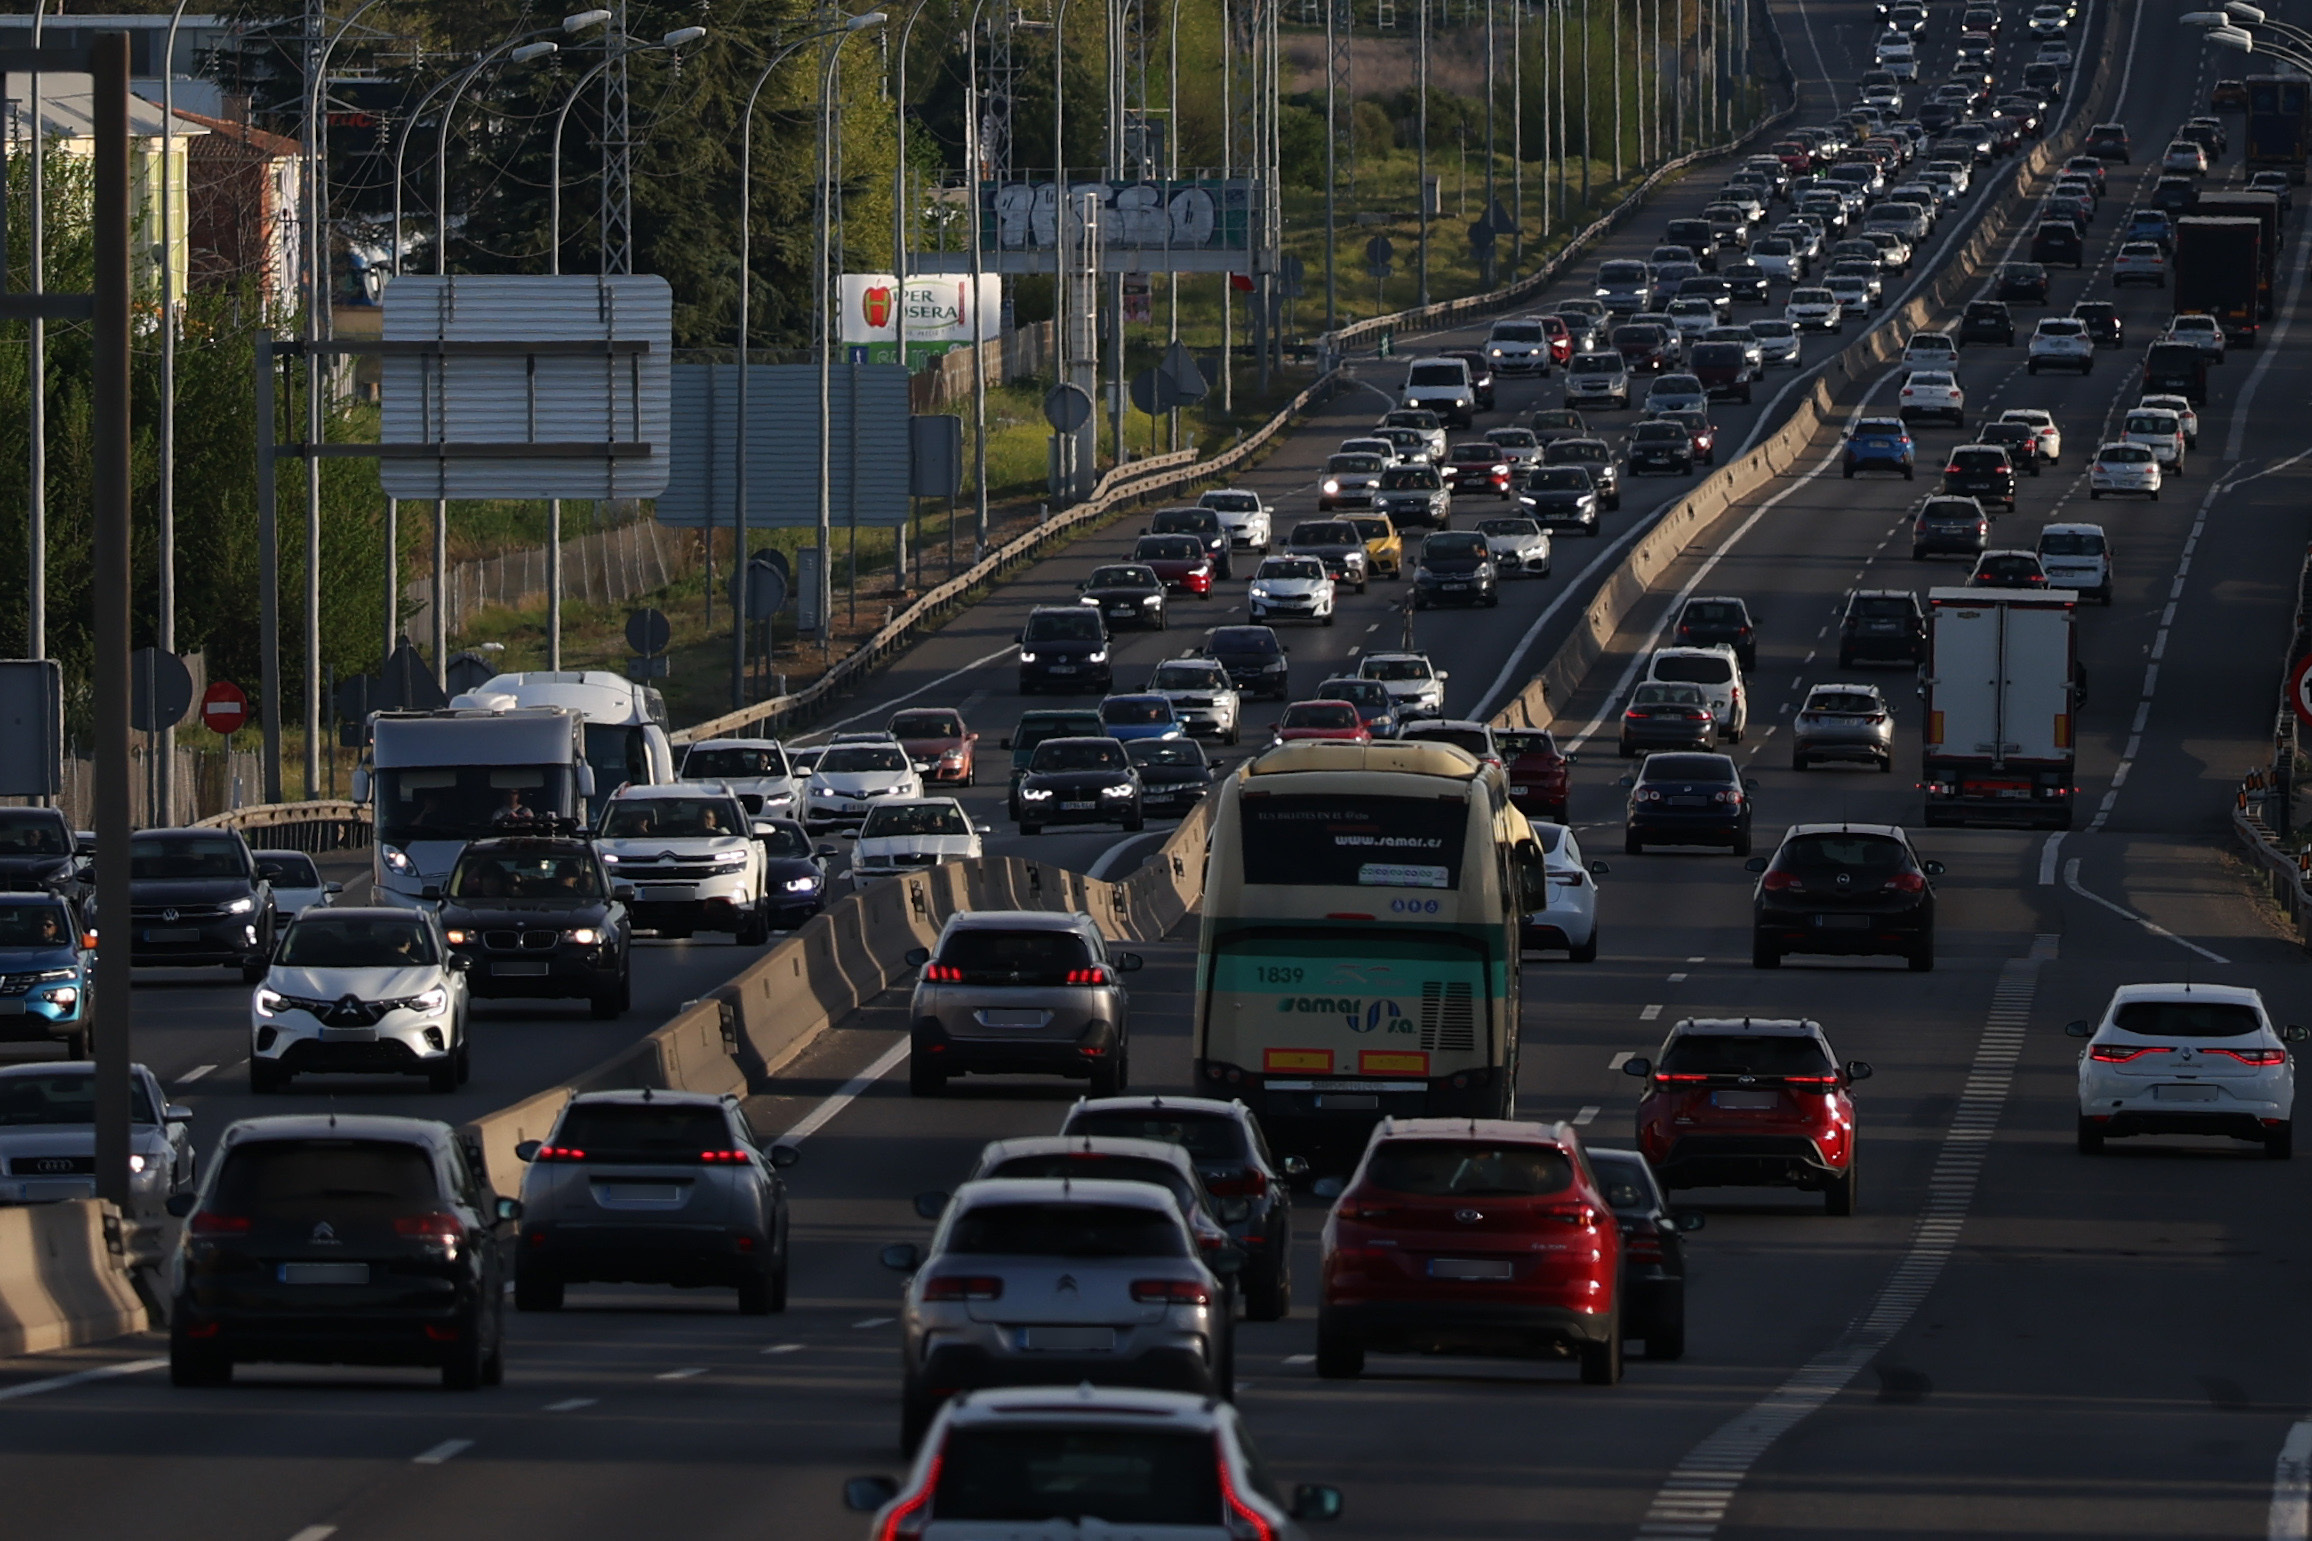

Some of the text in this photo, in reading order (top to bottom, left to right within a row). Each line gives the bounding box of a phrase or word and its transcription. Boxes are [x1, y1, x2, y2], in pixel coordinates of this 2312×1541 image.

[1334, 835, 1442, 848] www.samar.es
[1257, 966, 1304, 983] 1839
[1277, 998, 1361, 1013] samar
